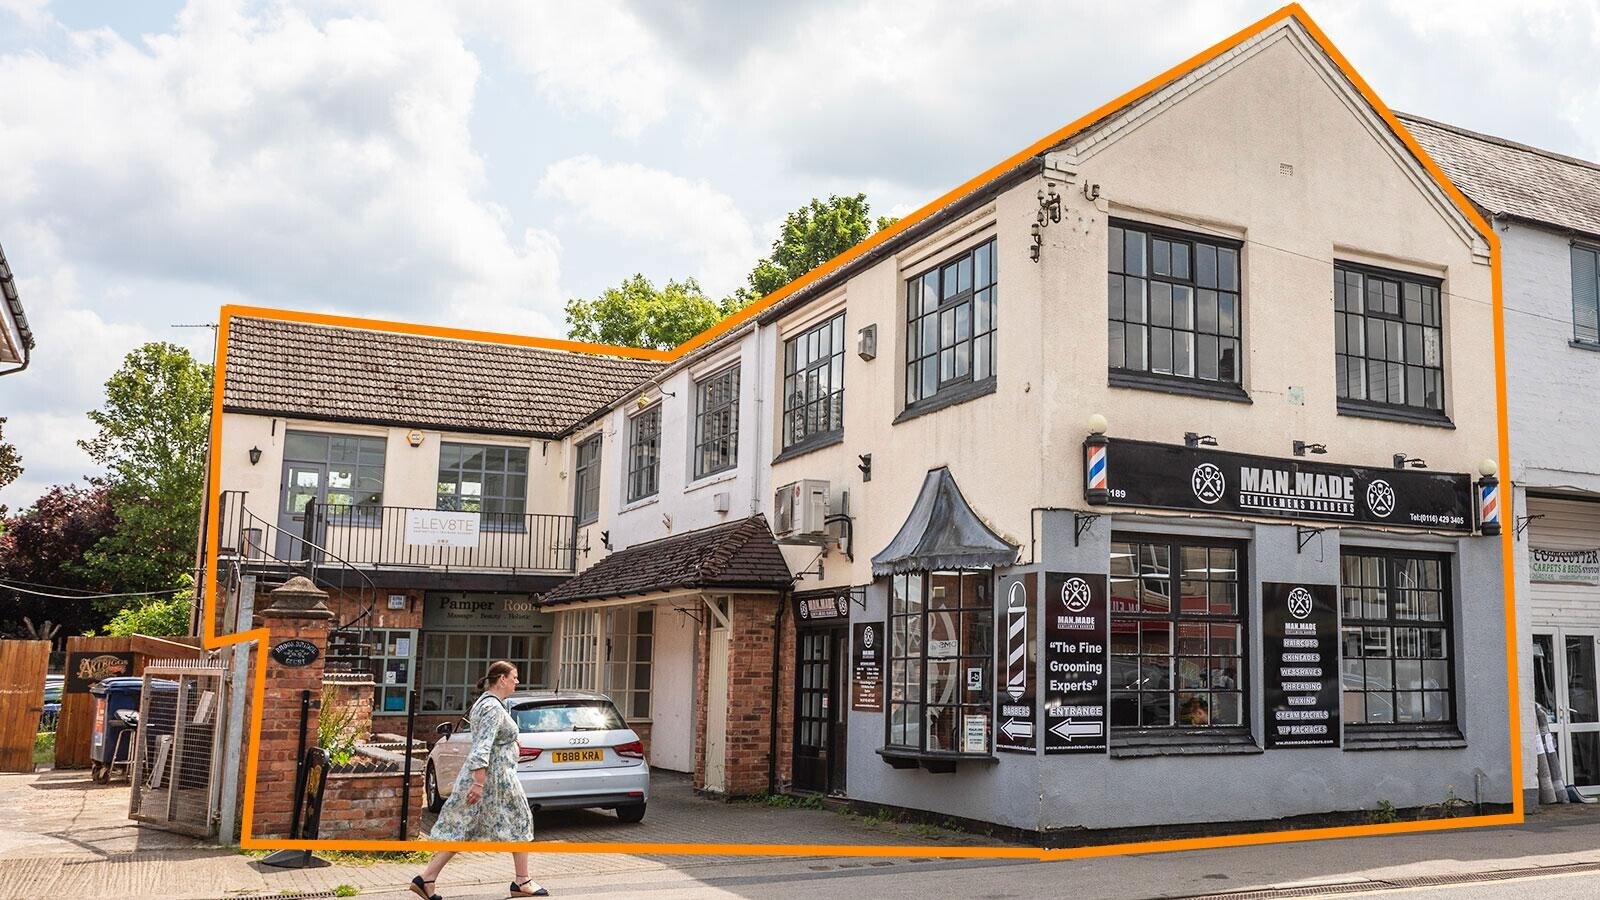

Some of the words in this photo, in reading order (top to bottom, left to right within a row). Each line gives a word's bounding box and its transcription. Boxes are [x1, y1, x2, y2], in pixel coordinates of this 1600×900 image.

[1240, 466, 1354, 500] MAN.MADE
[1240, 494, 1305, 509] GENTLEMENS
[1309, 501, 1355, 513] BARBERS
[1533, 562, 1561, 573] CARPETS
[439, 596, 495, 613] Pamper
[1058, 616, 1095, 625] MAN.MADE
[1050, 642, 1076, 653] “The
[1079, 642, 1102, 653] Fine
[1050, 661, 1103, 674] Grooming
[1050, 680, 1098, 693] Experts”
[1002, 706, 1031, 717] BARBERS
[1049, 706, 1103, 716] ENTRANCE
[556, 752, 580, 761] T888
[582, 750, 600, 760] KRA
